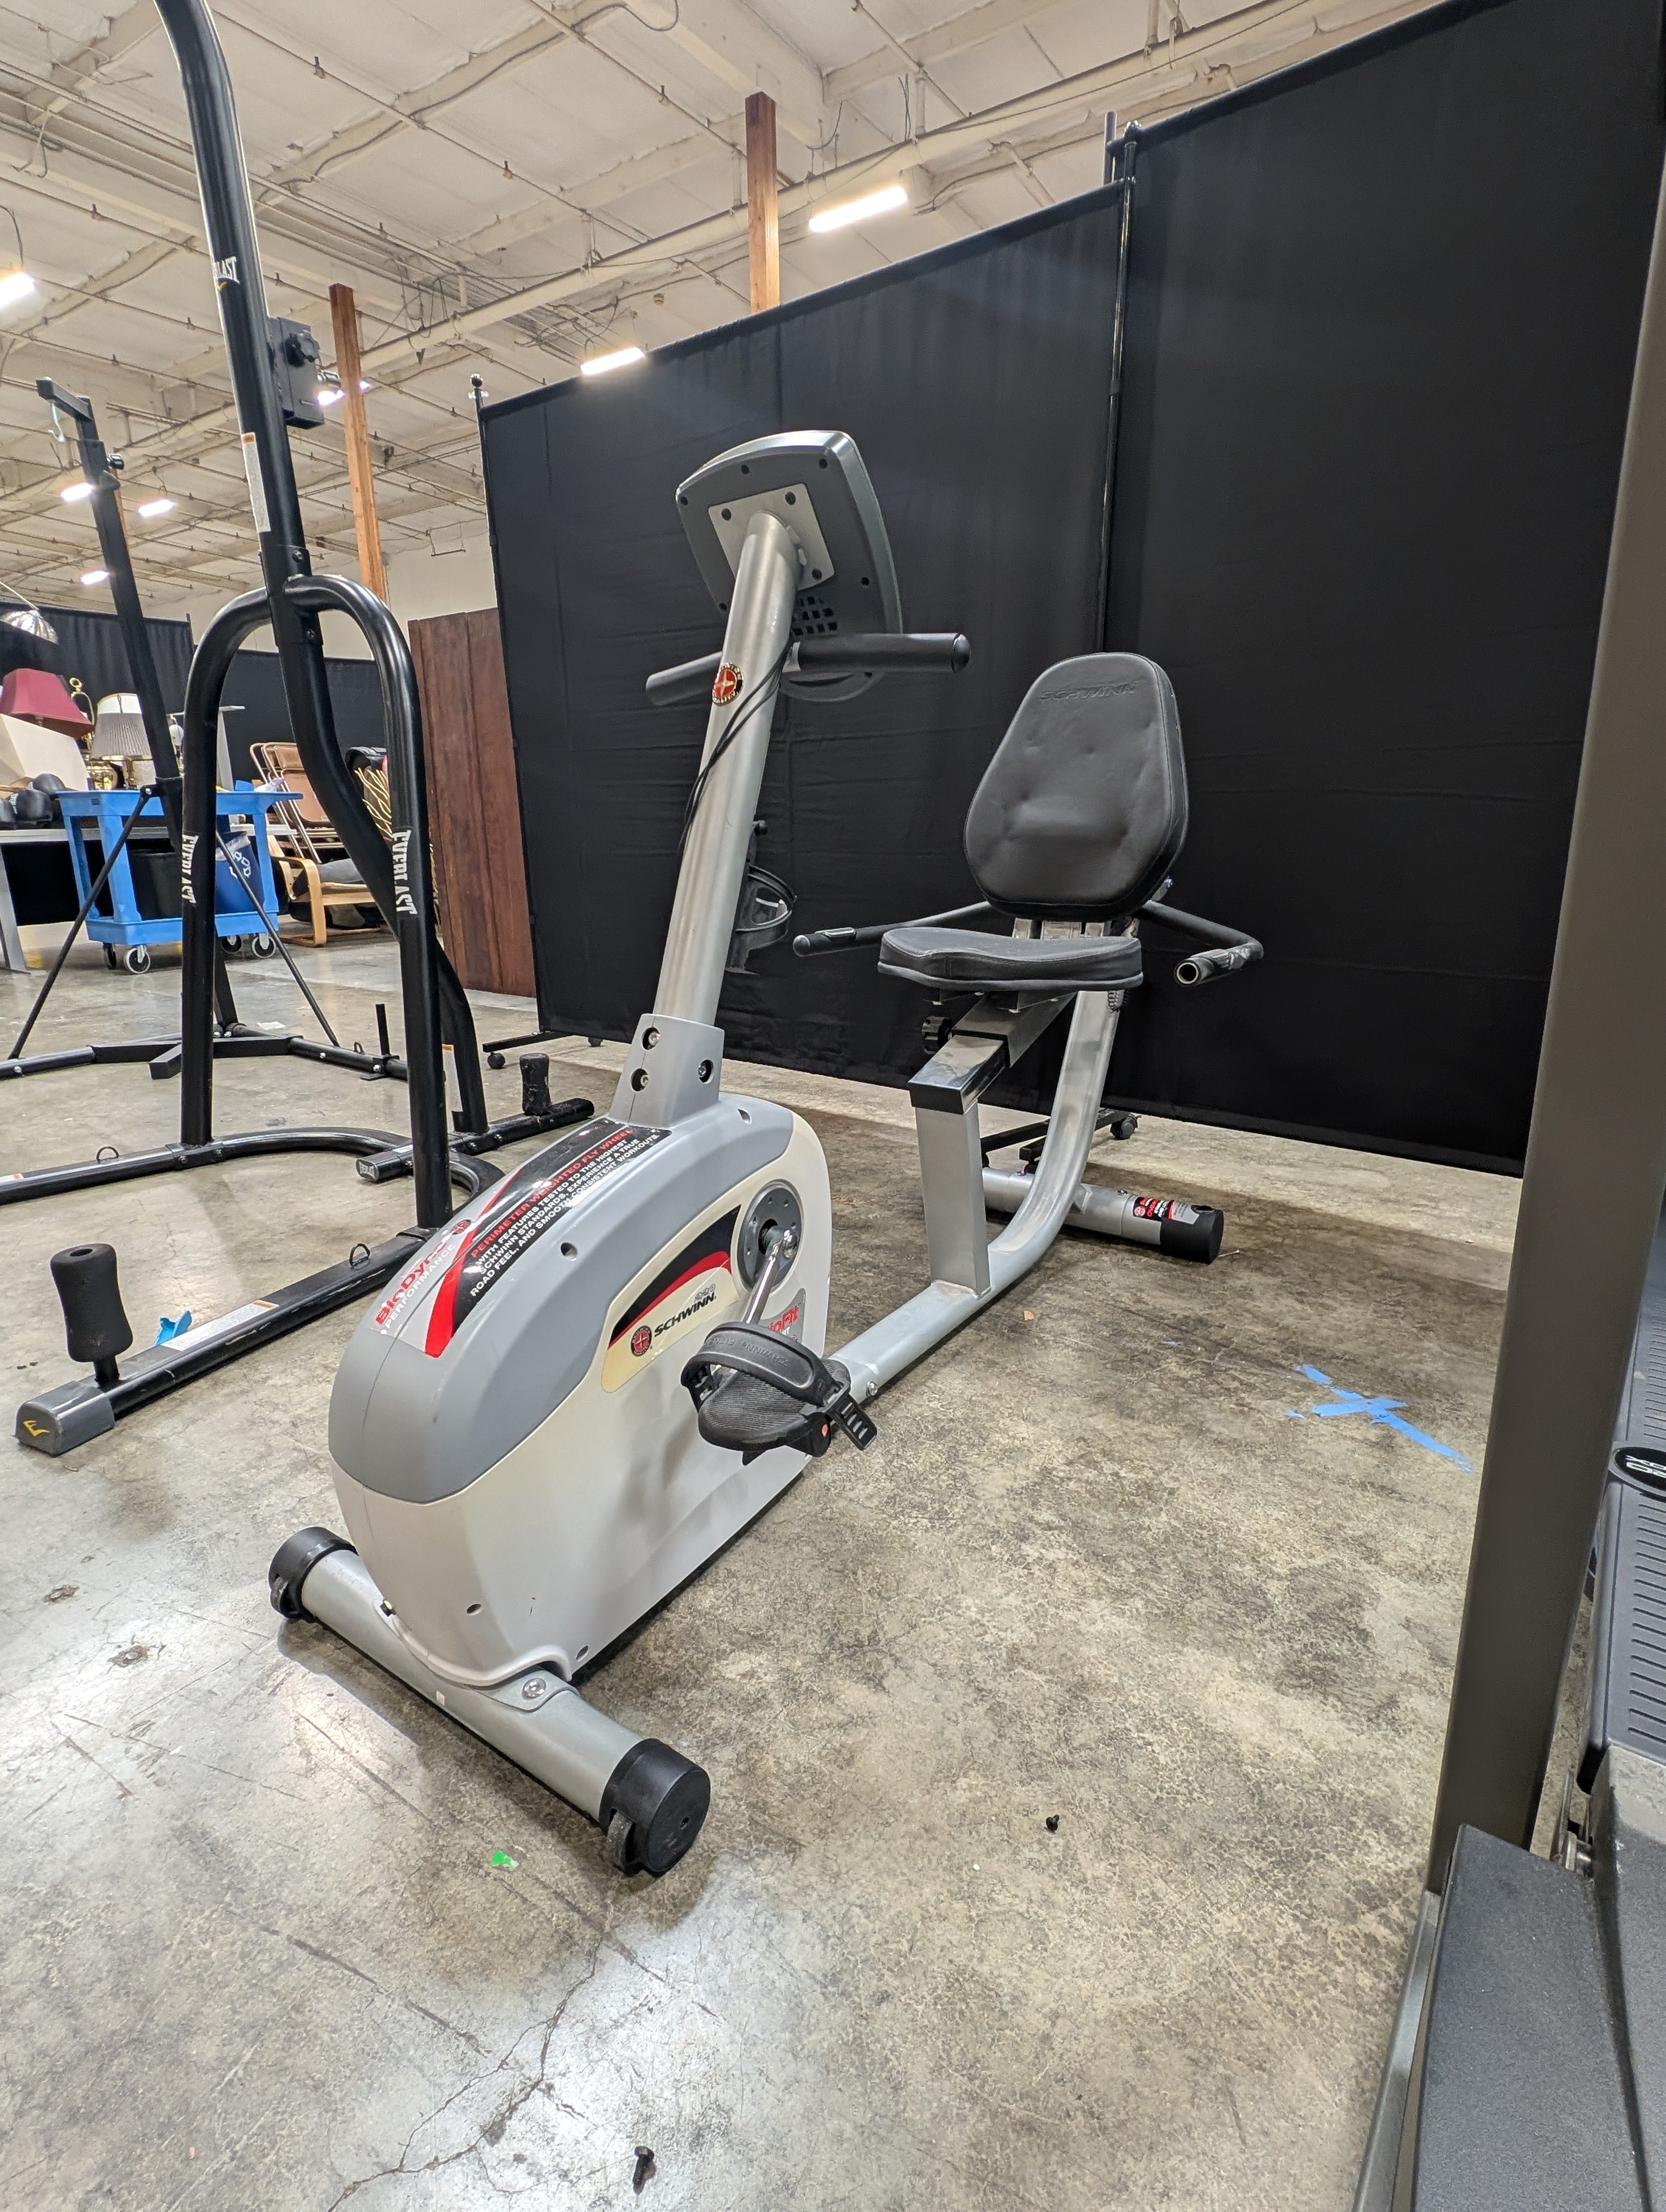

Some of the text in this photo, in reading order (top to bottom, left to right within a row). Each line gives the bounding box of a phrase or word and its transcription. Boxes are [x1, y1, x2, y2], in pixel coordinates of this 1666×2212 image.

[1038, 681, 1139, 702] SCHWINN
[470, 1203, 530, 1258] PERIMETER
[581, 1149, 598, 1163] FLY
[599, 1129, 633, 1150] WHEEL
[470, 1134, 660, 1296] ROAD FEEL, AND SMOOTH CONSISTENT WORKOUTS.
[475, 1139, 627, 1266] WITH FEATURES TESTED TO THE HIGHEST
[480, 1235, 518, 1274] SCHWINN
[567, 1157, 614, 1192] EXPERIENCE
[619, 1139, 640, 1153] TRUE
[385, 1244, 456, 1328] PERFORMANCE
[654, 1291, 716, 1338] SCHWINN
